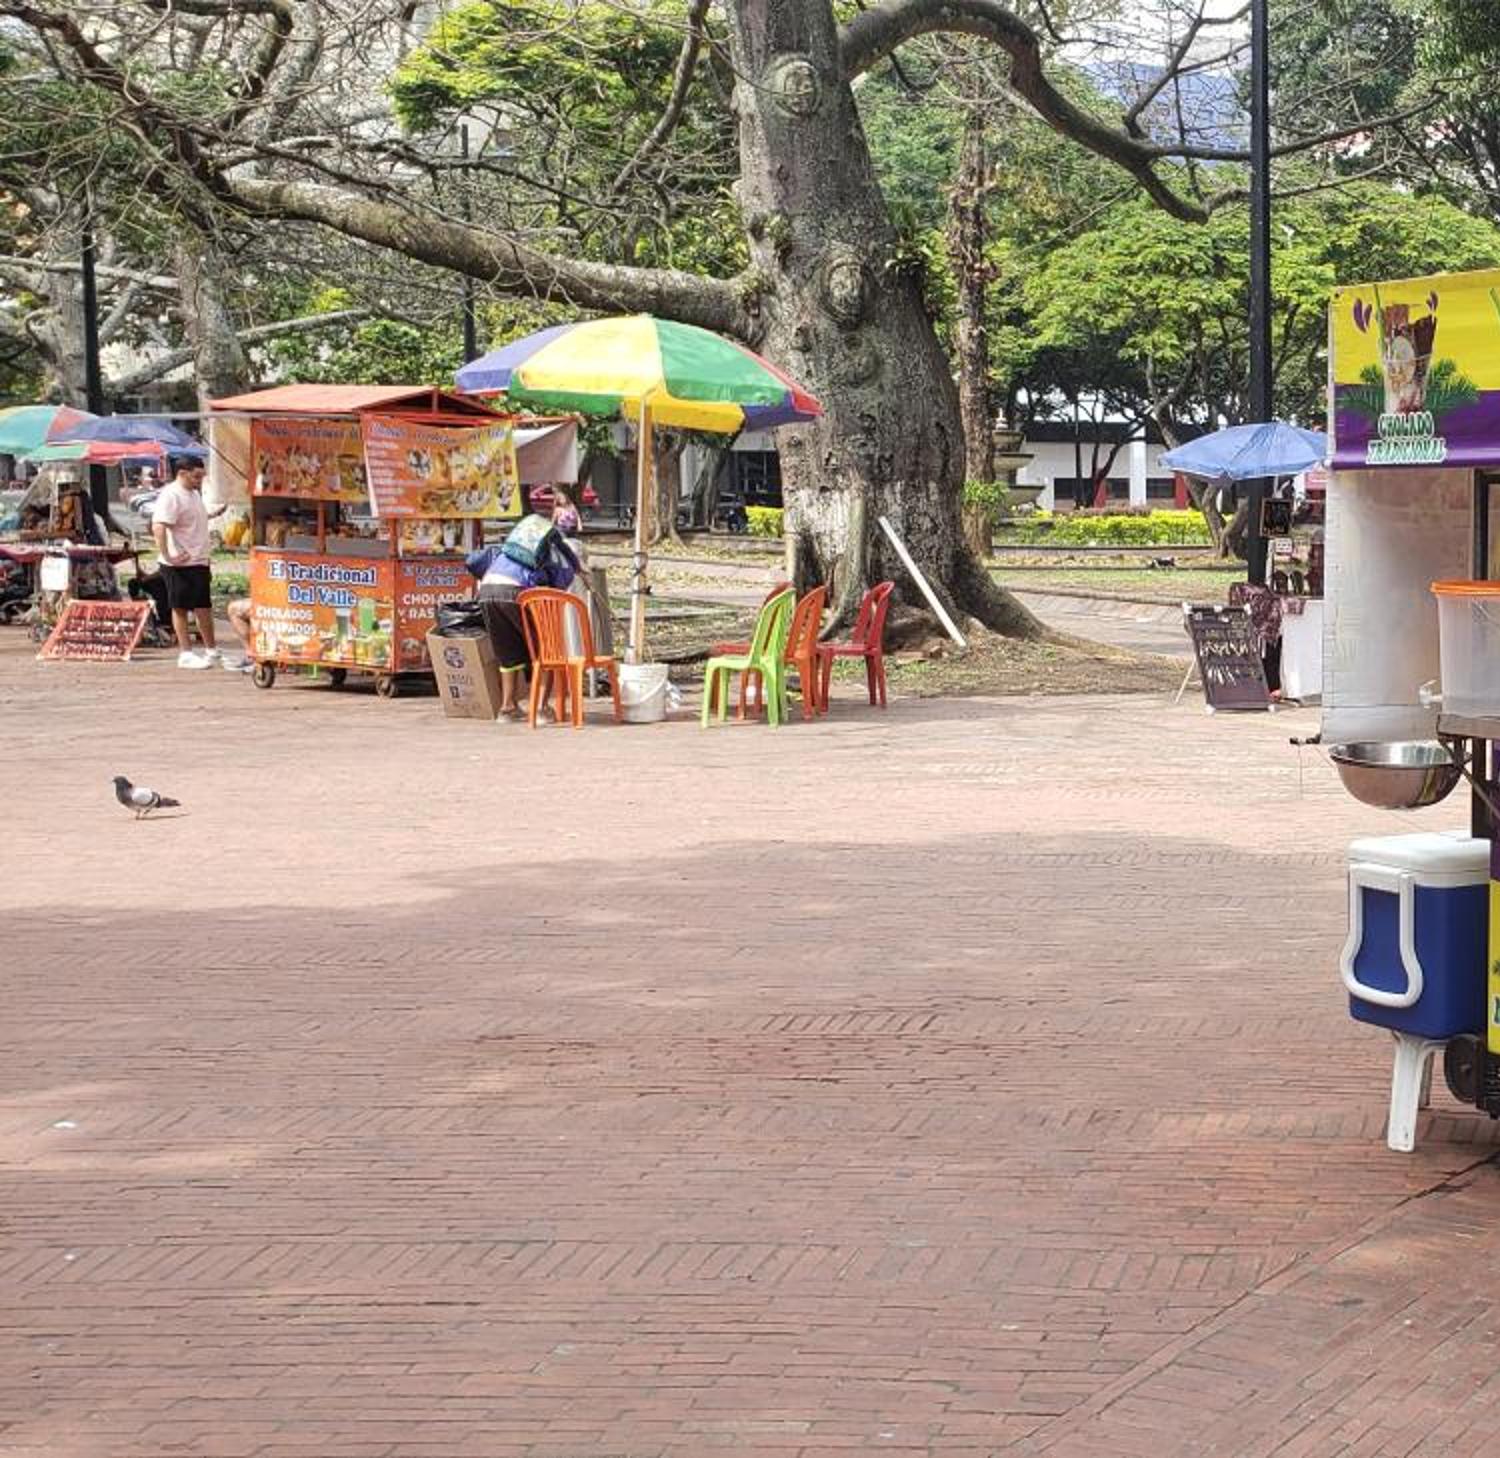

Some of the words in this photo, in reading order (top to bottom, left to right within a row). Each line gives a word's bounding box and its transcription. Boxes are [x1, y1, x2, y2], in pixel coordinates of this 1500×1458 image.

[288, 562, 378, 586] Tradicional
[288, 584, 315, 604] Del
[317, 587, 357, 608] Valle
[403, 593, 469, 605] CHOLADO
